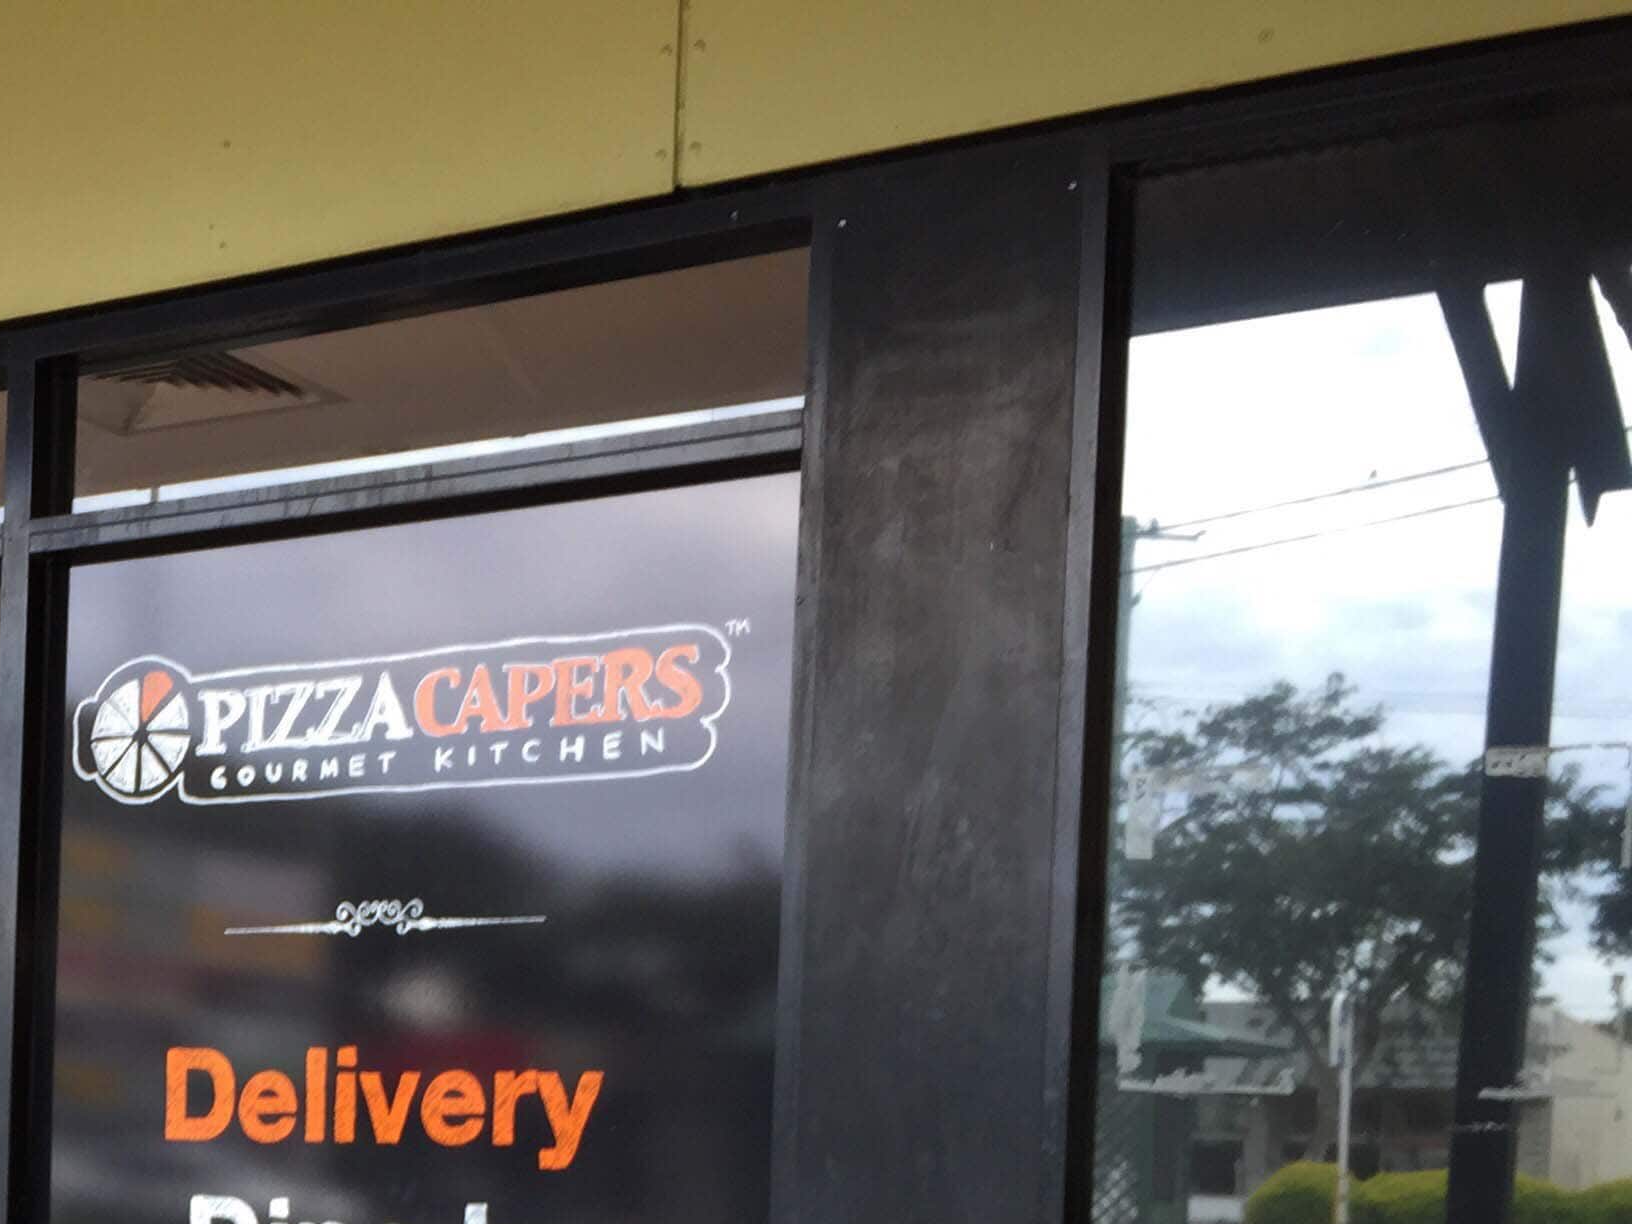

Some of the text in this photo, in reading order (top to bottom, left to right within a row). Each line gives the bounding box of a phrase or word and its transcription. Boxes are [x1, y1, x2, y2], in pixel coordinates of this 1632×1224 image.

[210, 727, 665, 790] GOURMET KITCHEN
[164, 1045, 604, 1170] Delivery
